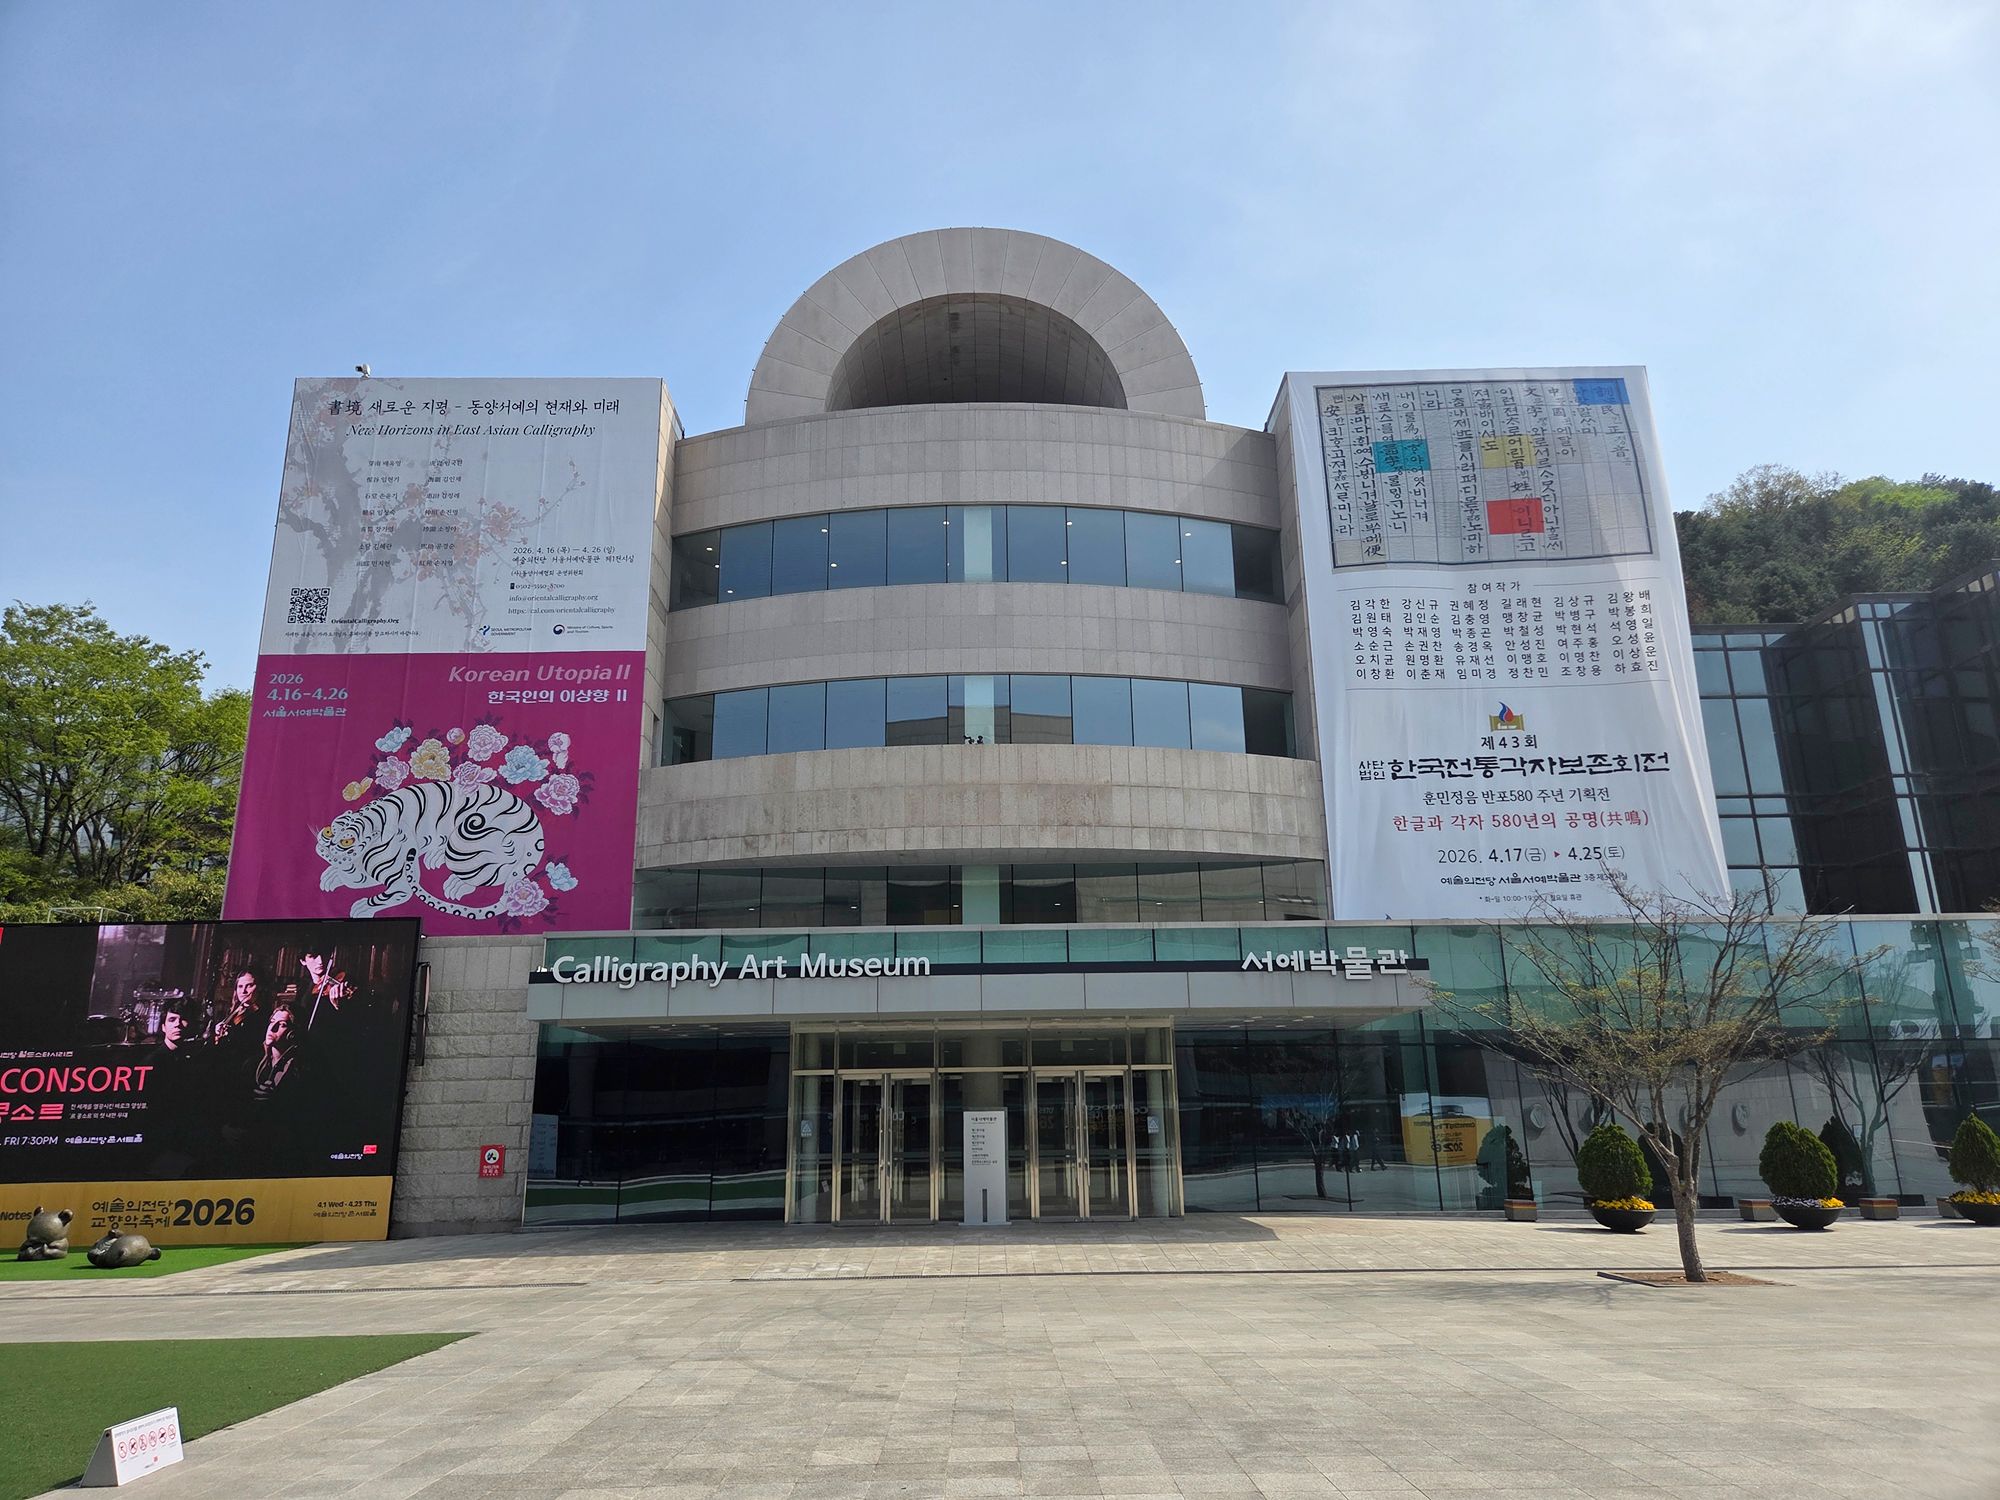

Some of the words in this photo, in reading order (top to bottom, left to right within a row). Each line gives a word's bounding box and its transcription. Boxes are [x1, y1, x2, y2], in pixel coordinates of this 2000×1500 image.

[371, 399, 416, 415] 새로운
[422, 399, 447, 416] 지평
[467, 399, 538, 416] 동양서예의
[545, 399, 588, 415] 현재와
[593, 399, 620, 415] 미래
[347, 424, 375, 437] New
[377, 424, 434, 437] Horizons
[438, 424, 451, 436] in
[453, 424, 481, 436] East
[484, 424, 520, 436] Asian
[523, 424, 596, 439] Calligraphy
[582, 546, 590, 554] 4.
[1467, 581, 1521, 594] 참여작가
[1350, 598, 1391, 611] 김각한
[1401, 598, 1439, 610] 강신규
[1450, 599, 1489, 612] 권혜정
[1501, 597, 1542, 610] 길래현
[1554, 595, 1595, 608] 김상규
[1608, 589, 1651, 604] 김왕배
[1351, 612, 1392, 624] 김원태
[1402, 612, 1440, 624] 김인순
[1502, 611, 1543, 624] 맹창균
[1555, 609, 1596, 621] 박병구
[1352, 626, 1392, 638] 박영숙
[1403, 626, 1441, 638] 박재영
[1503, 625, 1544, 637] 박철성
[1556, 623, 1597, 635] 박현석
[1610, 618, 1653, 632] 석영일
[1354, 640, 1393, 651] 소순근
[1404, 640, 1442, 652] 손권찬
[1454, 641, 1493, 653] 송경옥
[1505, 639, 1546, 651] 안성진
[1355, 654, 1394, 666] 오치균
[1405, 654, 1444, 666] 원명환
[1455, 655, 1495, 666] 유재선
[1506, 653, 1547, 665] 이맹호
[1559, 650, 1600, 663] 이명찬
[449, 665, 530, 683] Korean
[536, 665, 612, 684] Utopia
[1356, 668, 1395, 680] 이창환
[1406, 668, 1446, 680] 이춘재
[1457, 668, 1496, 680] 임미경
[1508, 667, 1549, 679] 정찬민
[1561, 665, 1602, 677] 조창용
[1614, 660, 1659, 674] 하효진
[269, 673, 304, 685] 2026
[266, 686, 349, 701] 4.16-4.26
[487, 689, 554, 705] 한국인의
[560, 688, 610, 704] 이상향
[263, 705, 347, 718] 서울서예박물관
[1358, 760, 1385, 770] 사단
[1388, 752, 1670, 779] 한국전통각자보존회전
[1359, 770, 1385, 781] 법인
[1422, 790, 1478, 806] 훈민정음
[1537, 788, 1565, 803] 주년
[1569, 787, 1611, 802] 기획전
[1392, 815, 1444, 832] 한글과
[1450, 814, 1484, 831] 각자
[1491, 812, 1556, 829] 580년의
[1438, 849, 1483, 864] 2026.
[1488, 848, 1547, 863] 4.17(금)
[1568, 846, 1625, 861] 4.25(토)
[1440, 874, 1496, 887] 예술의전당
[1498, 872, 1582, 886] 서울서예박물관
[551, 954, 728, 989] Calligraphy
[738, 953, 787, 980] Art
[800, 952, 931, 979] Museum
[1241, 946, 1409, 980] 서예박물관
[0, 1065, 154, 1094] CONSORT
[4, 1136, 20, 1146] FRI
[21, 1135, 59, 1146] 7:30PM
[0, 1211, 32, 1221] Notes
[92, 1197, 174, 1215] 예술의전당
[172, 1197, 255, 1227] 2026
[91, 1214, 171, 1230] 교향악축제
